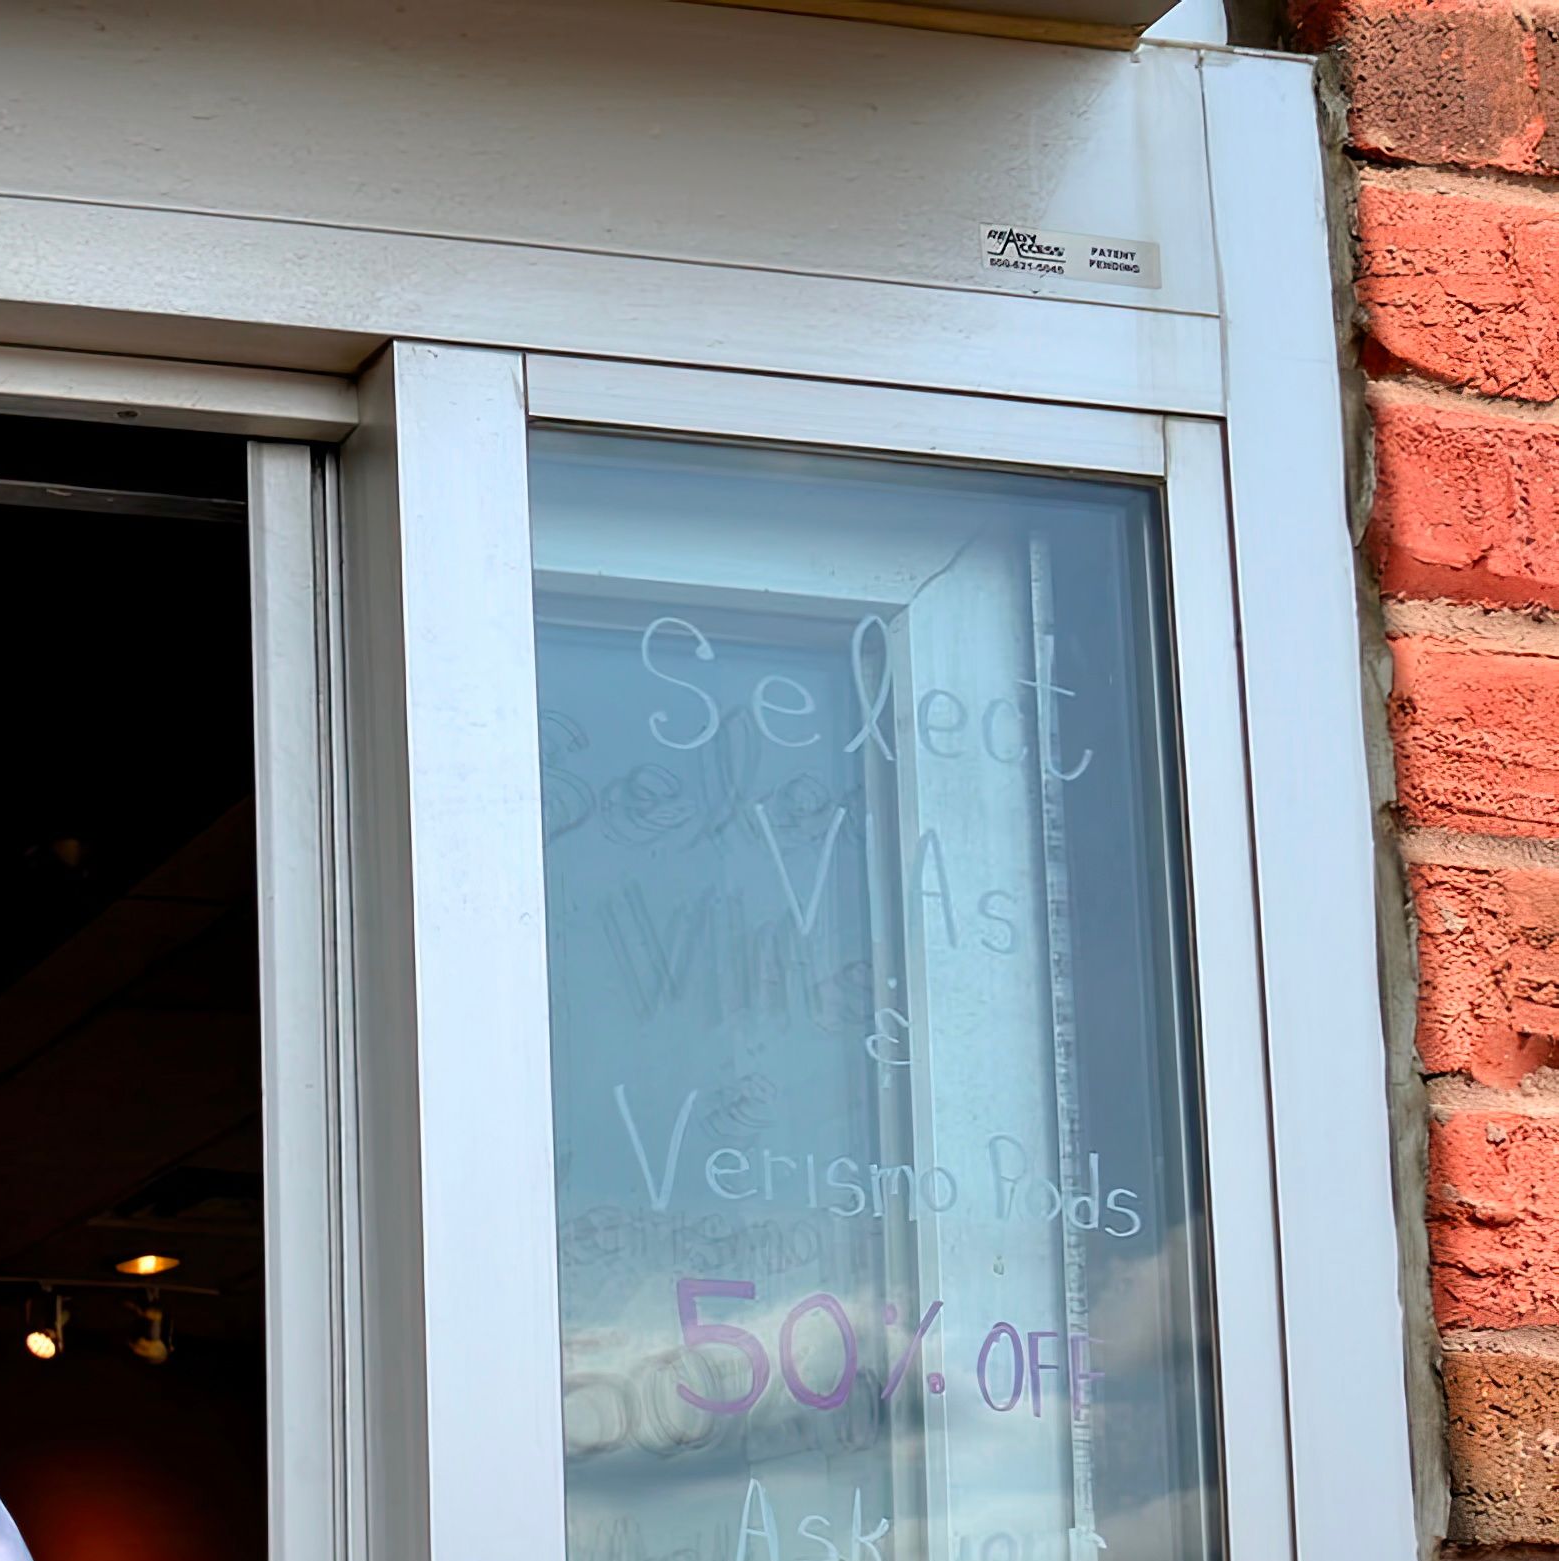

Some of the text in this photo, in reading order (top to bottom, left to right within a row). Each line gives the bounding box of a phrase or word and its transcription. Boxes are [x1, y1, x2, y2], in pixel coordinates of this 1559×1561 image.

[1088, 259, 1141, 274] PENDING
[1090, 246, 1137, 262] PATENT
[641, 614, 1093, 781] Select
[612, 1083, 1143, 1239] Verismo Pods
[676, 1278, 945, 1417] 50%
[977, 1321, 1106, 1419] OFF
